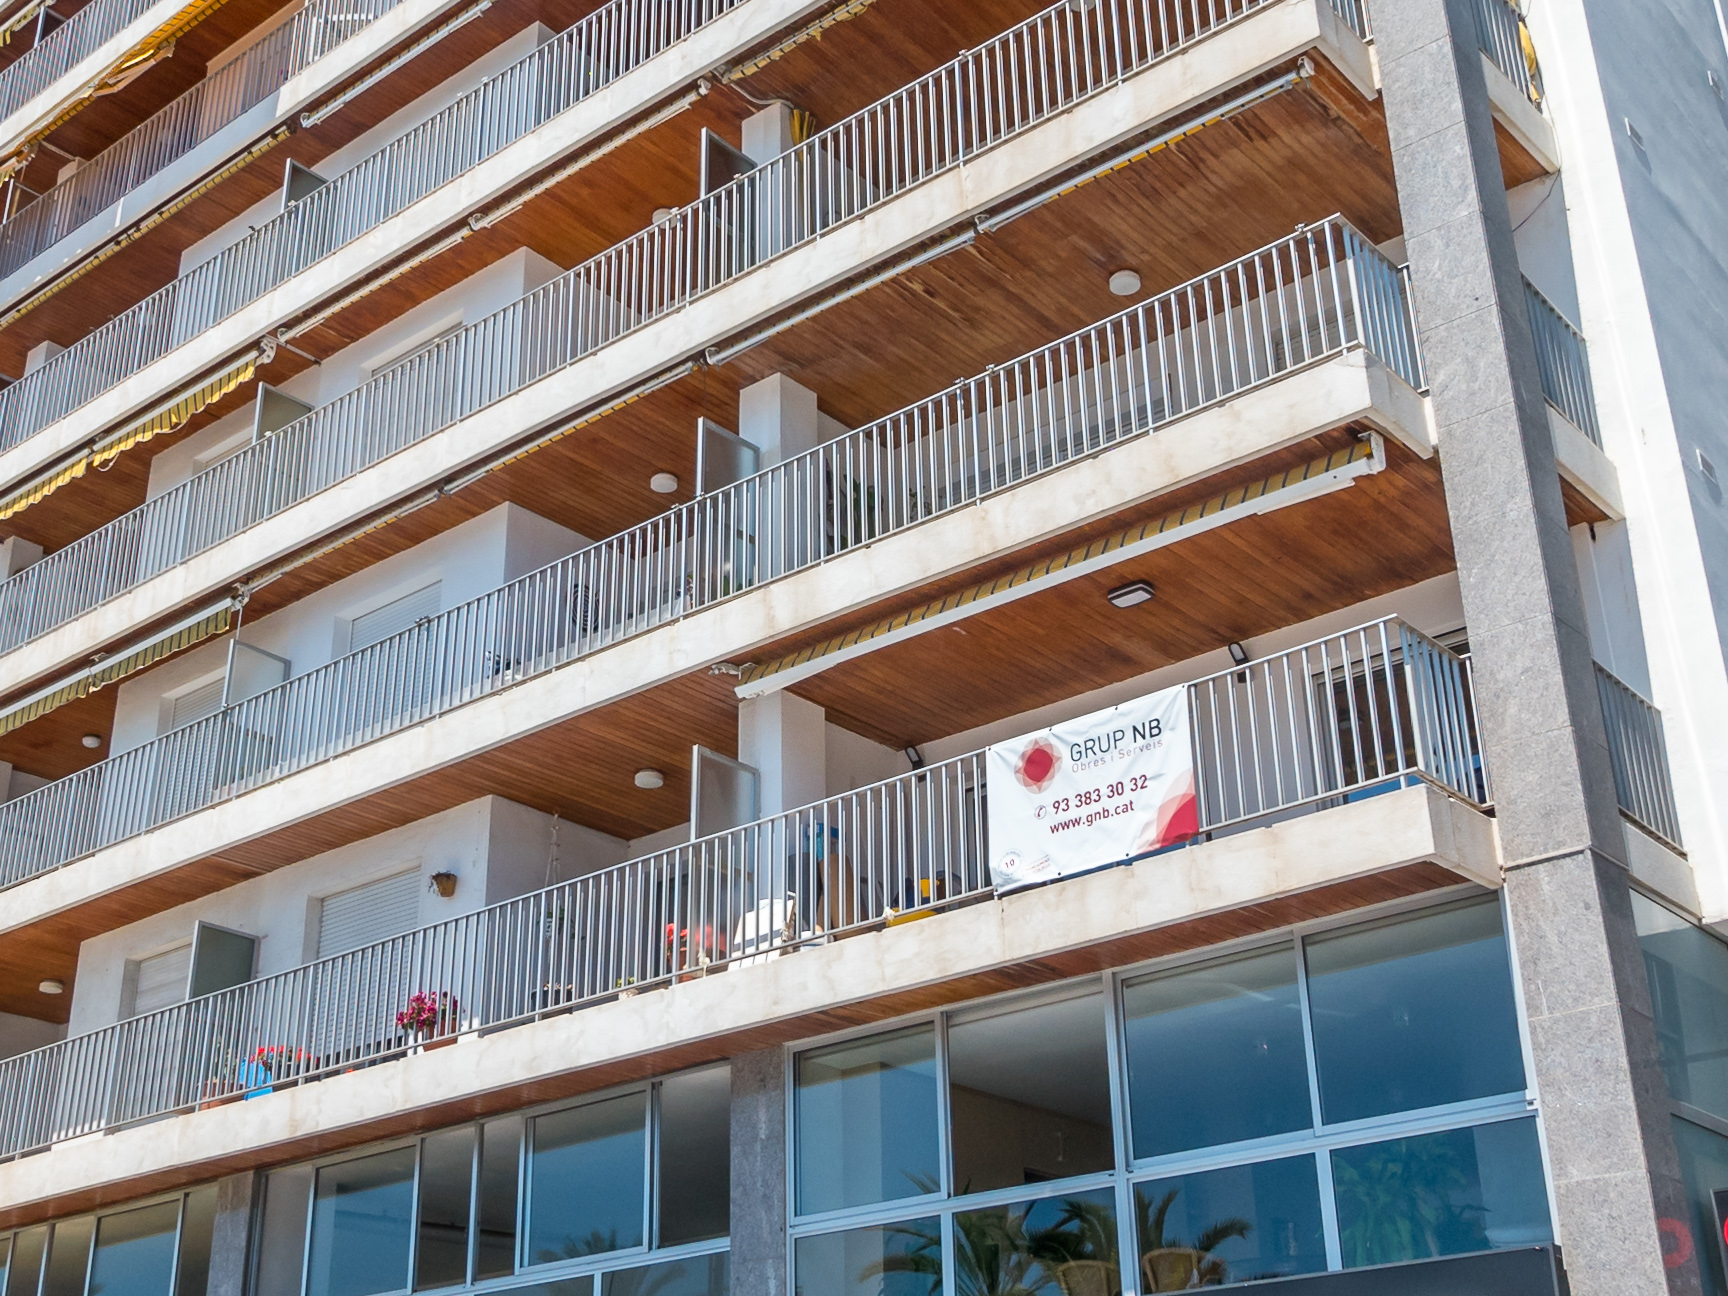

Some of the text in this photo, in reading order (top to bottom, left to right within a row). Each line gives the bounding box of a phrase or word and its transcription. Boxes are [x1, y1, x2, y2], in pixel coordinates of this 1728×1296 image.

[1069, 717, 1162, 762] GRUP NB
[1071, 757, 1106, 773] Obres
[1118, 739, 1163, 759] Serveis
[1052, 774, 1148, 815] 93 383 30 32
[1049, 800, 1135, 834] www.gnb.cat
